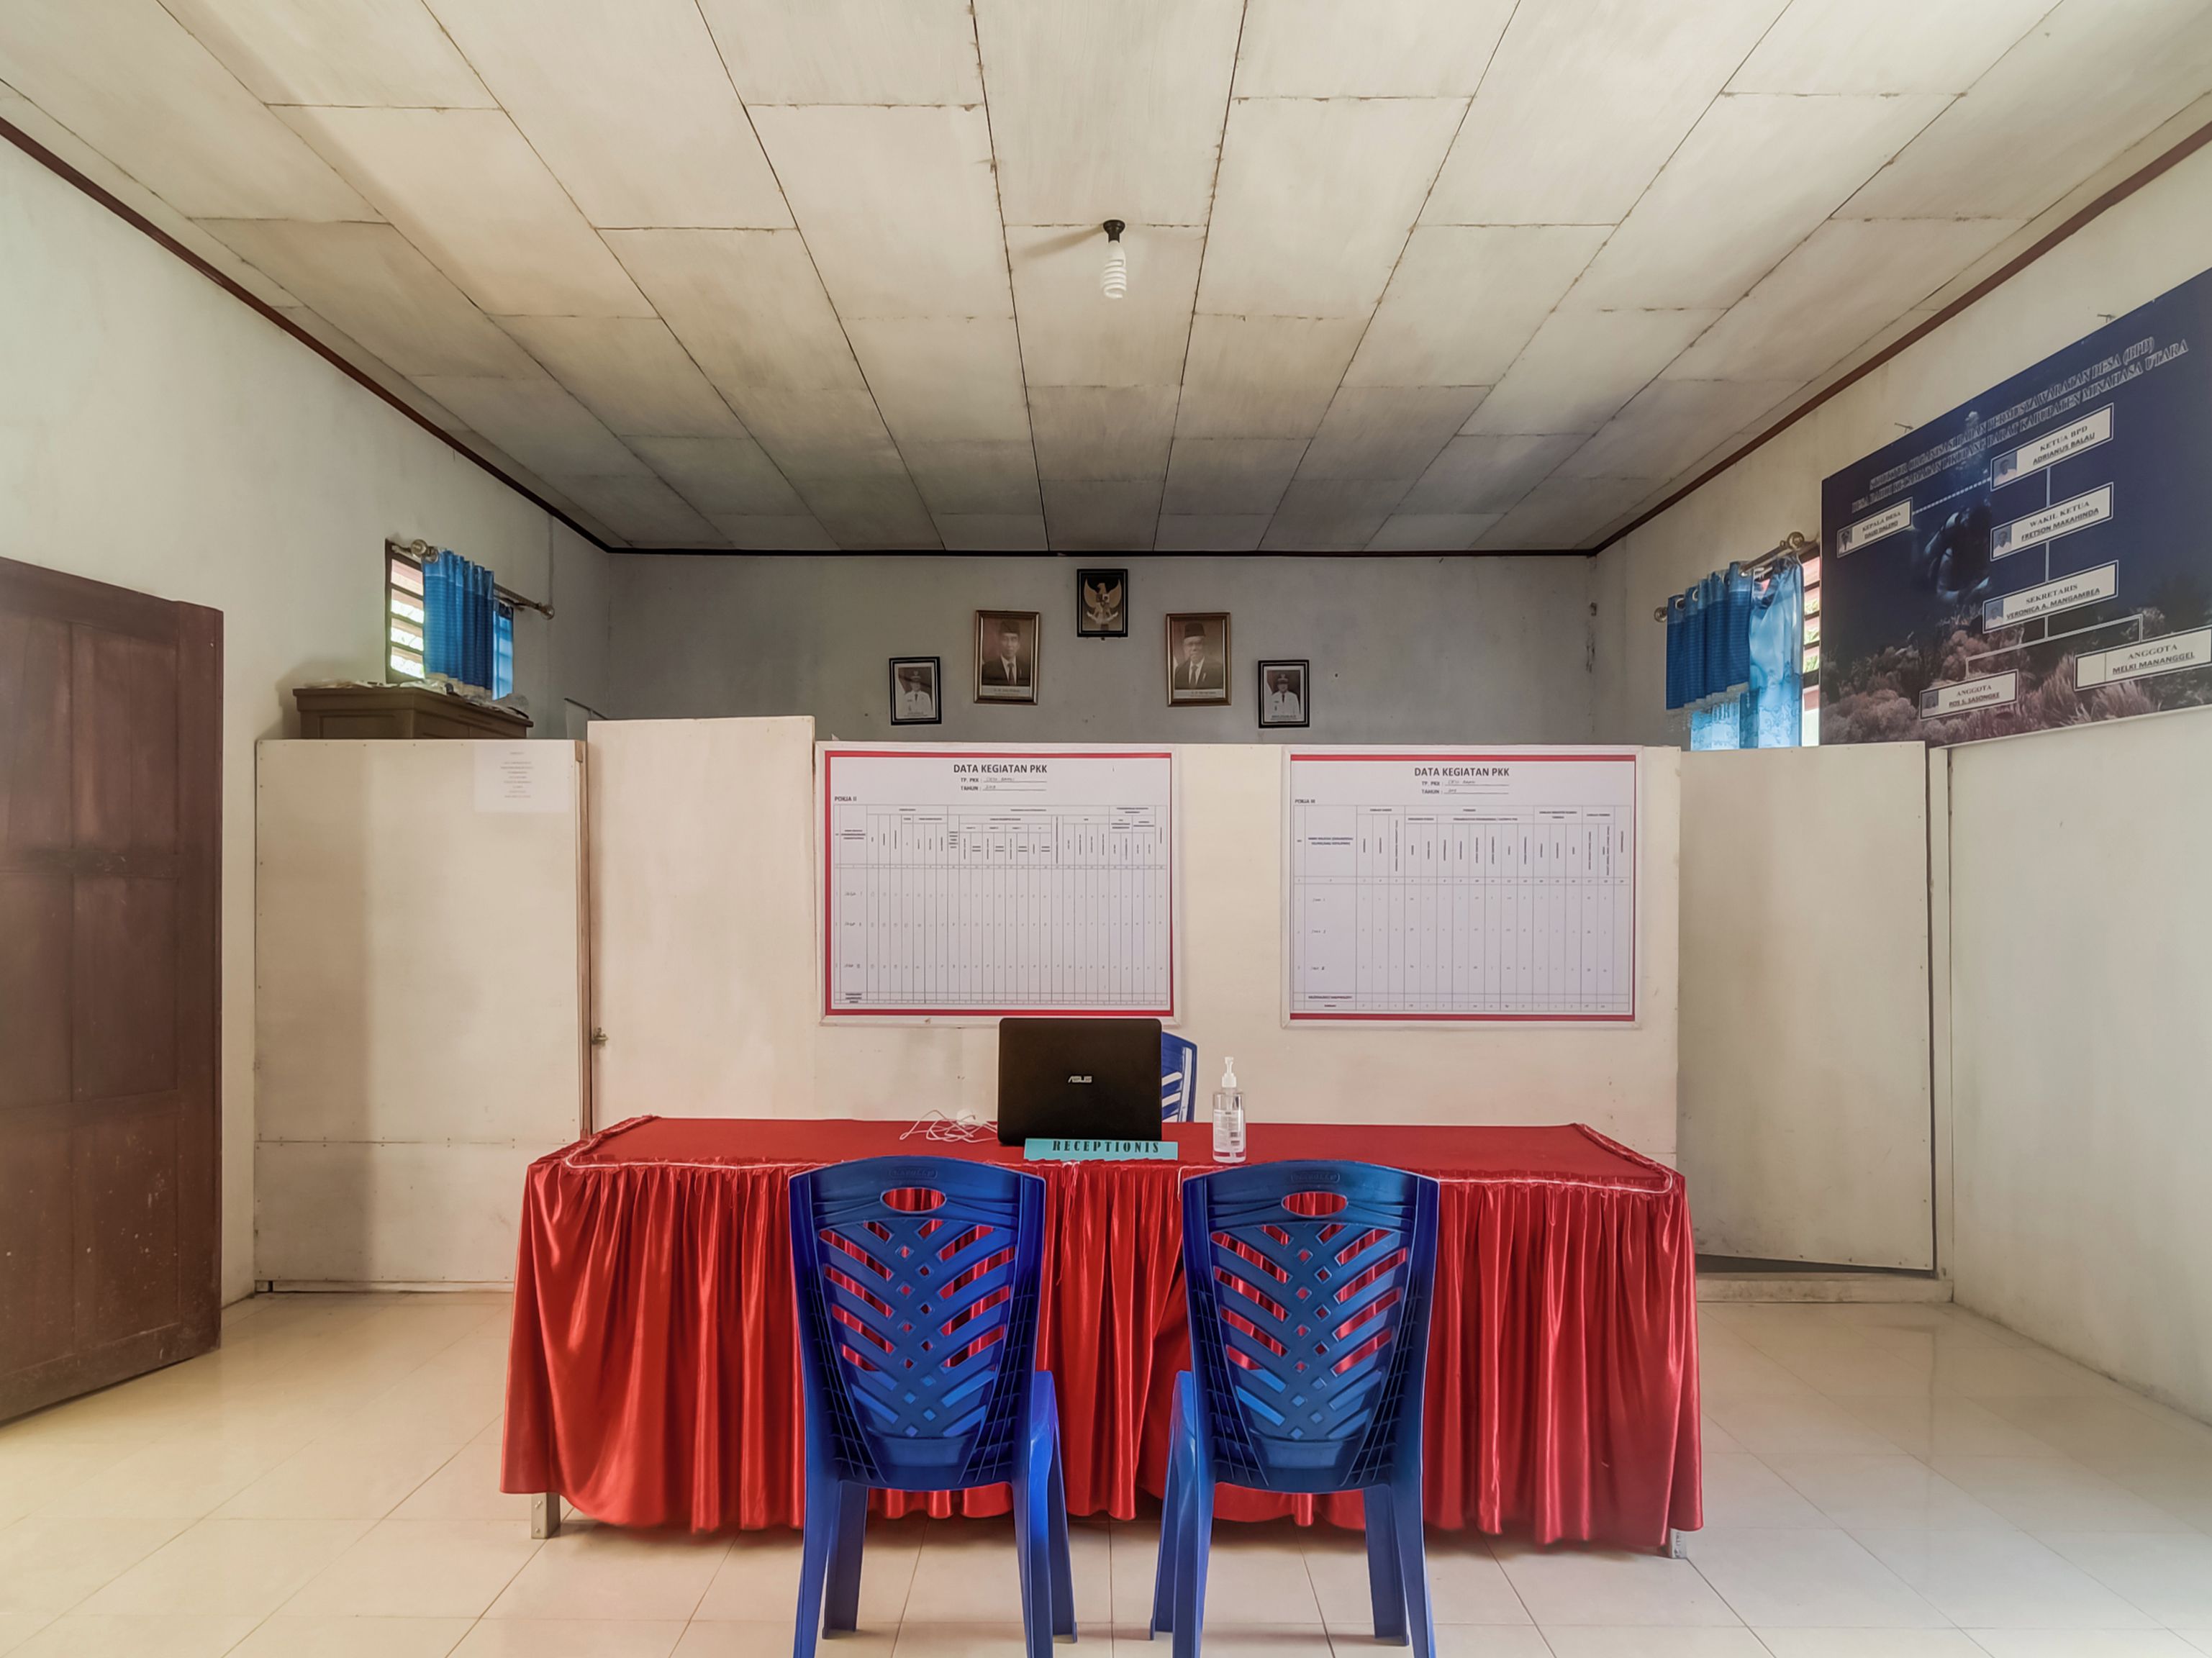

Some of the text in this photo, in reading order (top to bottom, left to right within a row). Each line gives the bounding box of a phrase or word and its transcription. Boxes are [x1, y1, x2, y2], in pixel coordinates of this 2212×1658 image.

[2144, 339, 2189, 371] UTARA
[2091, 353, 2121, 379] DESA
[2040, 425, 2088, 452] KETUA BPD
[2033, 433, 2095, 465] ADRIANUS BALAU
[2029, 500, 2090, 527] WAKIL KETUA
[1862, 518, 1885, 531] KEPALA
[2021, 507, 2100, 542] FRETSON MAKAHINDA
[2026, 584, 2078, 604] SEKRETARIS
[2006, 605, 2040, 620] VERONICA
[2041, 602, 2049, 611] A.
[2128, 644, 2177, 660] ANGGOTA
[2113, 651, 2195, 675] MELKI MANANGGEL
[1957, 684, 1992, 697] ANGGOTA
[953, 764, 1048, 774] DATA KEGIATAN PKK
[1414, 767, 1510, 776] DATA KEGIATAN PKK
[1053, 1140, 1160, 1153] RECEPTIONIS
